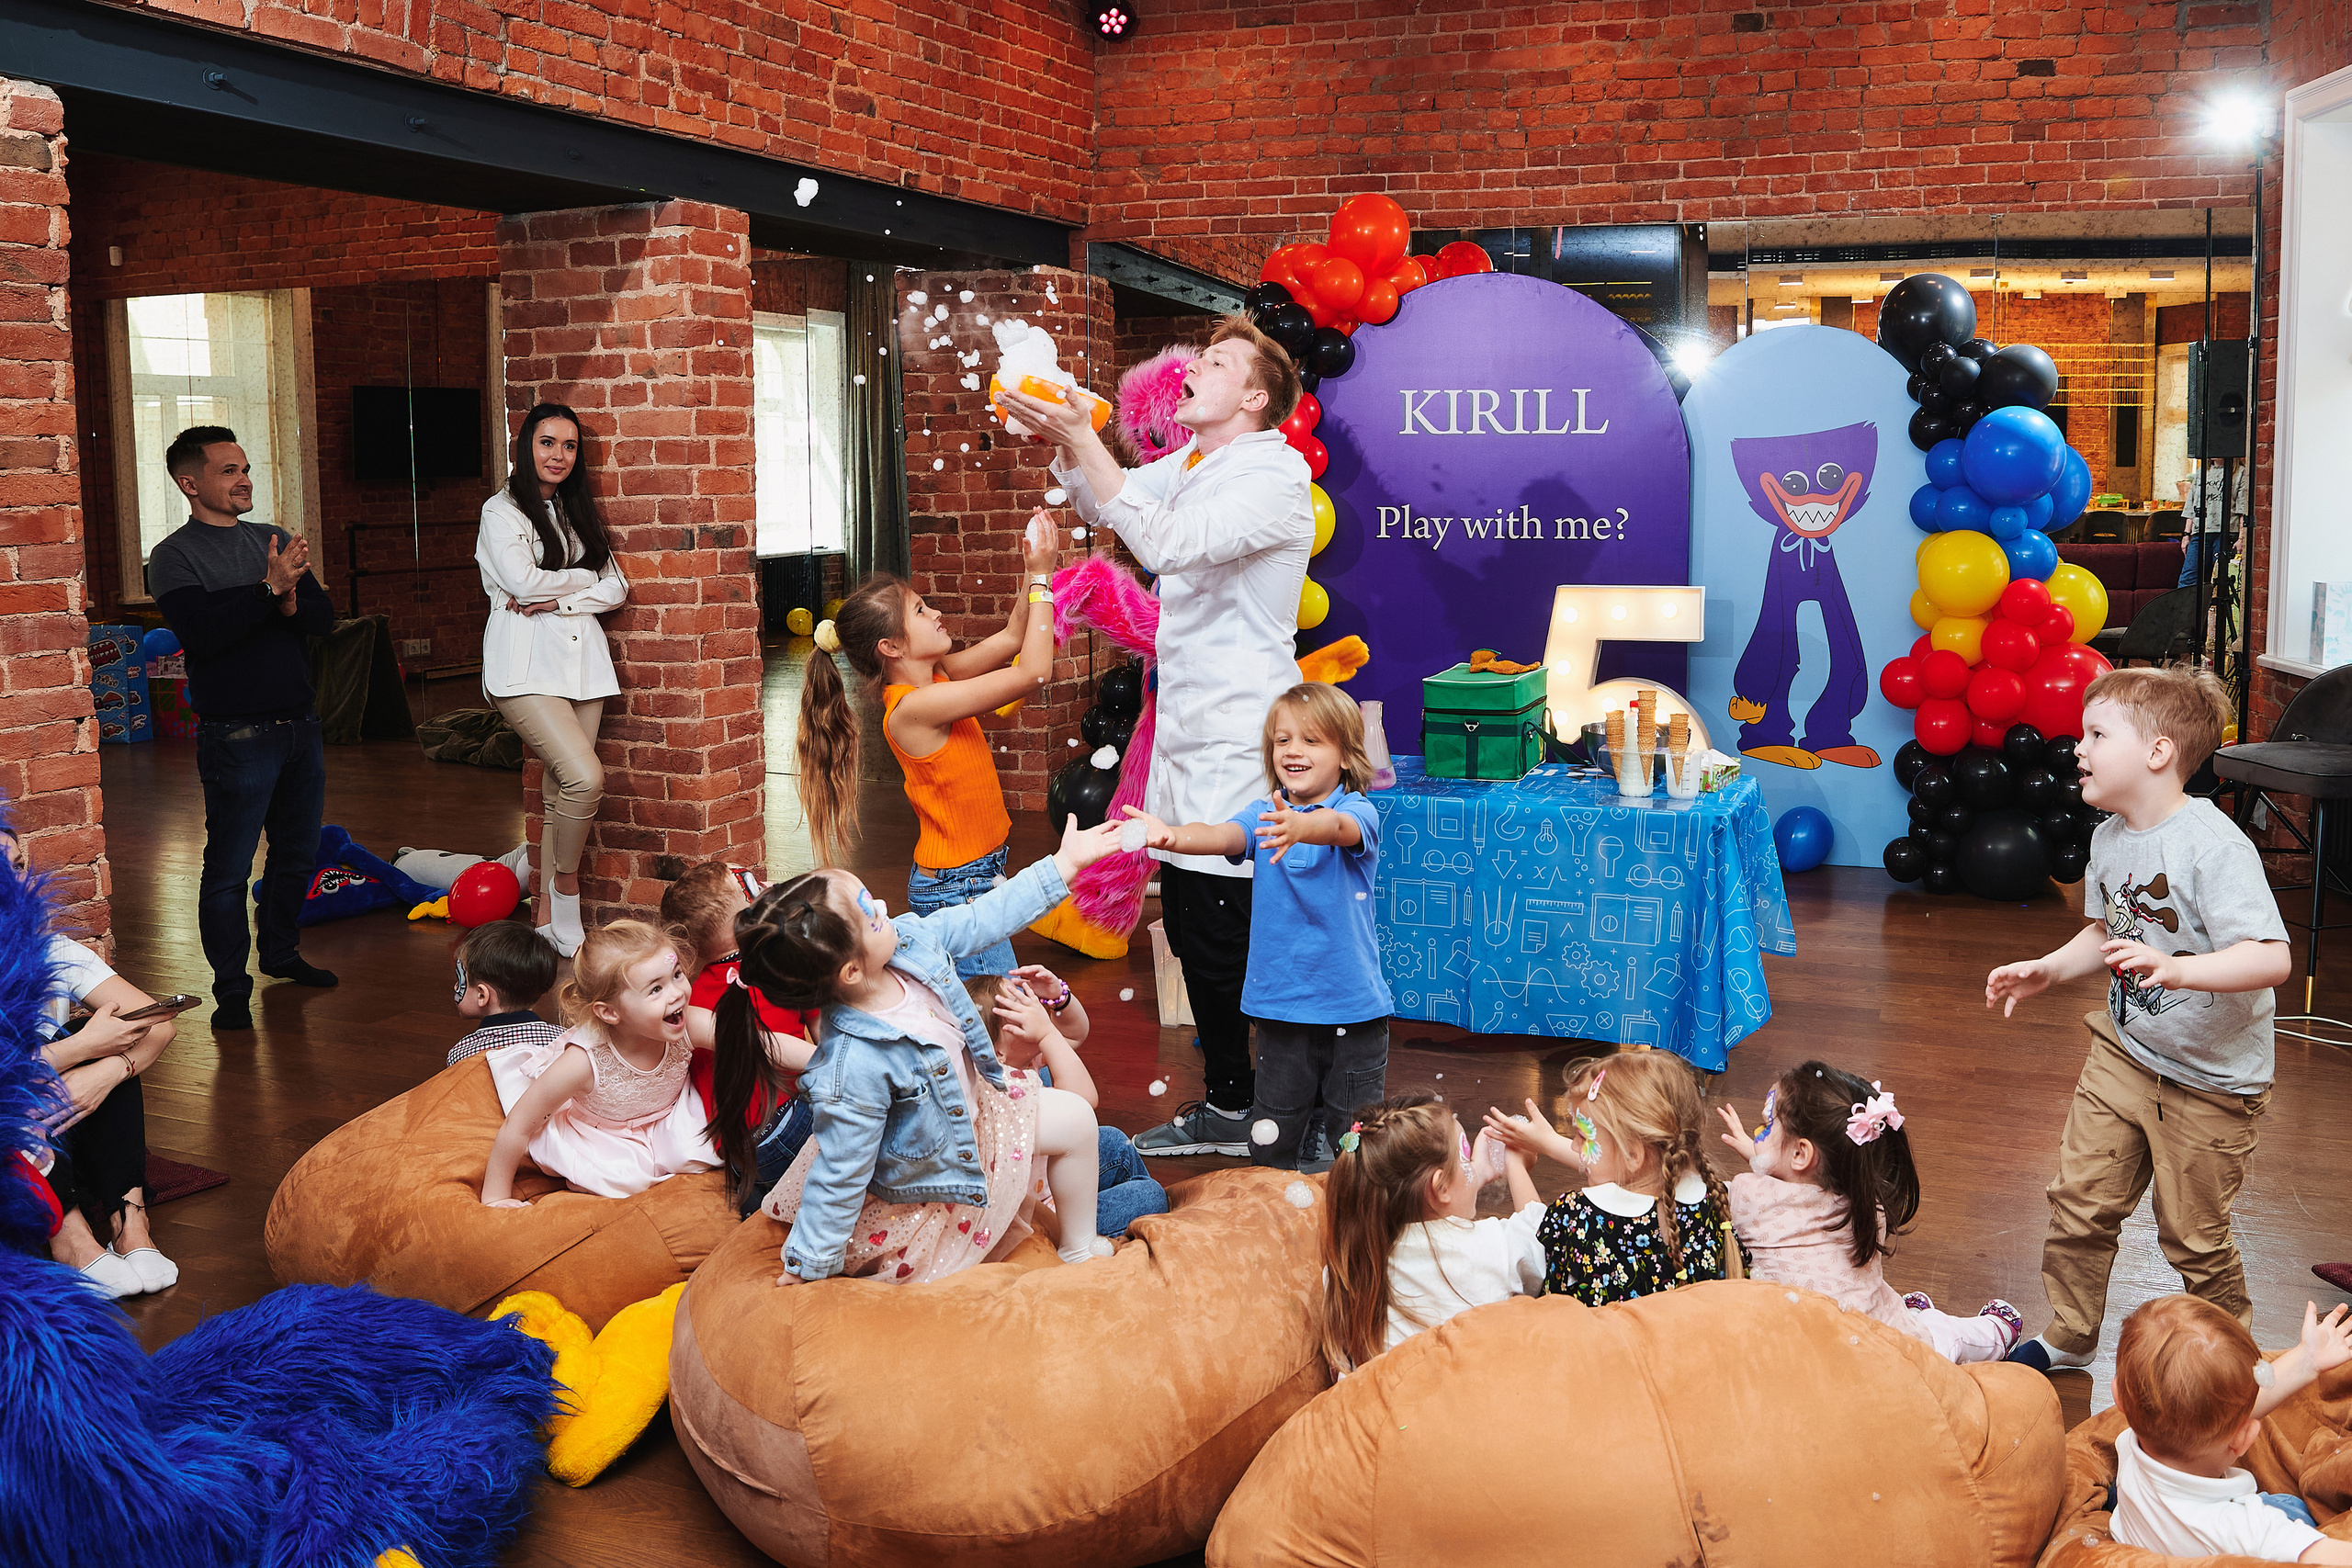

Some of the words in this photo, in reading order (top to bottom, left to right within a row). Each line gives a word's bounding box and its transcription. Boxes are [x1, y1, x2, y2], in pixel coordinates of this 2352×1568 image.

[1398, 389, 1610, 435] KIRILL
[1375, 503, 1453, 551] Play
[1461, 503, 1544, 540] with
[1554, 507, 1630, 540] me?
[1543, 584, 1713, 750] 5
